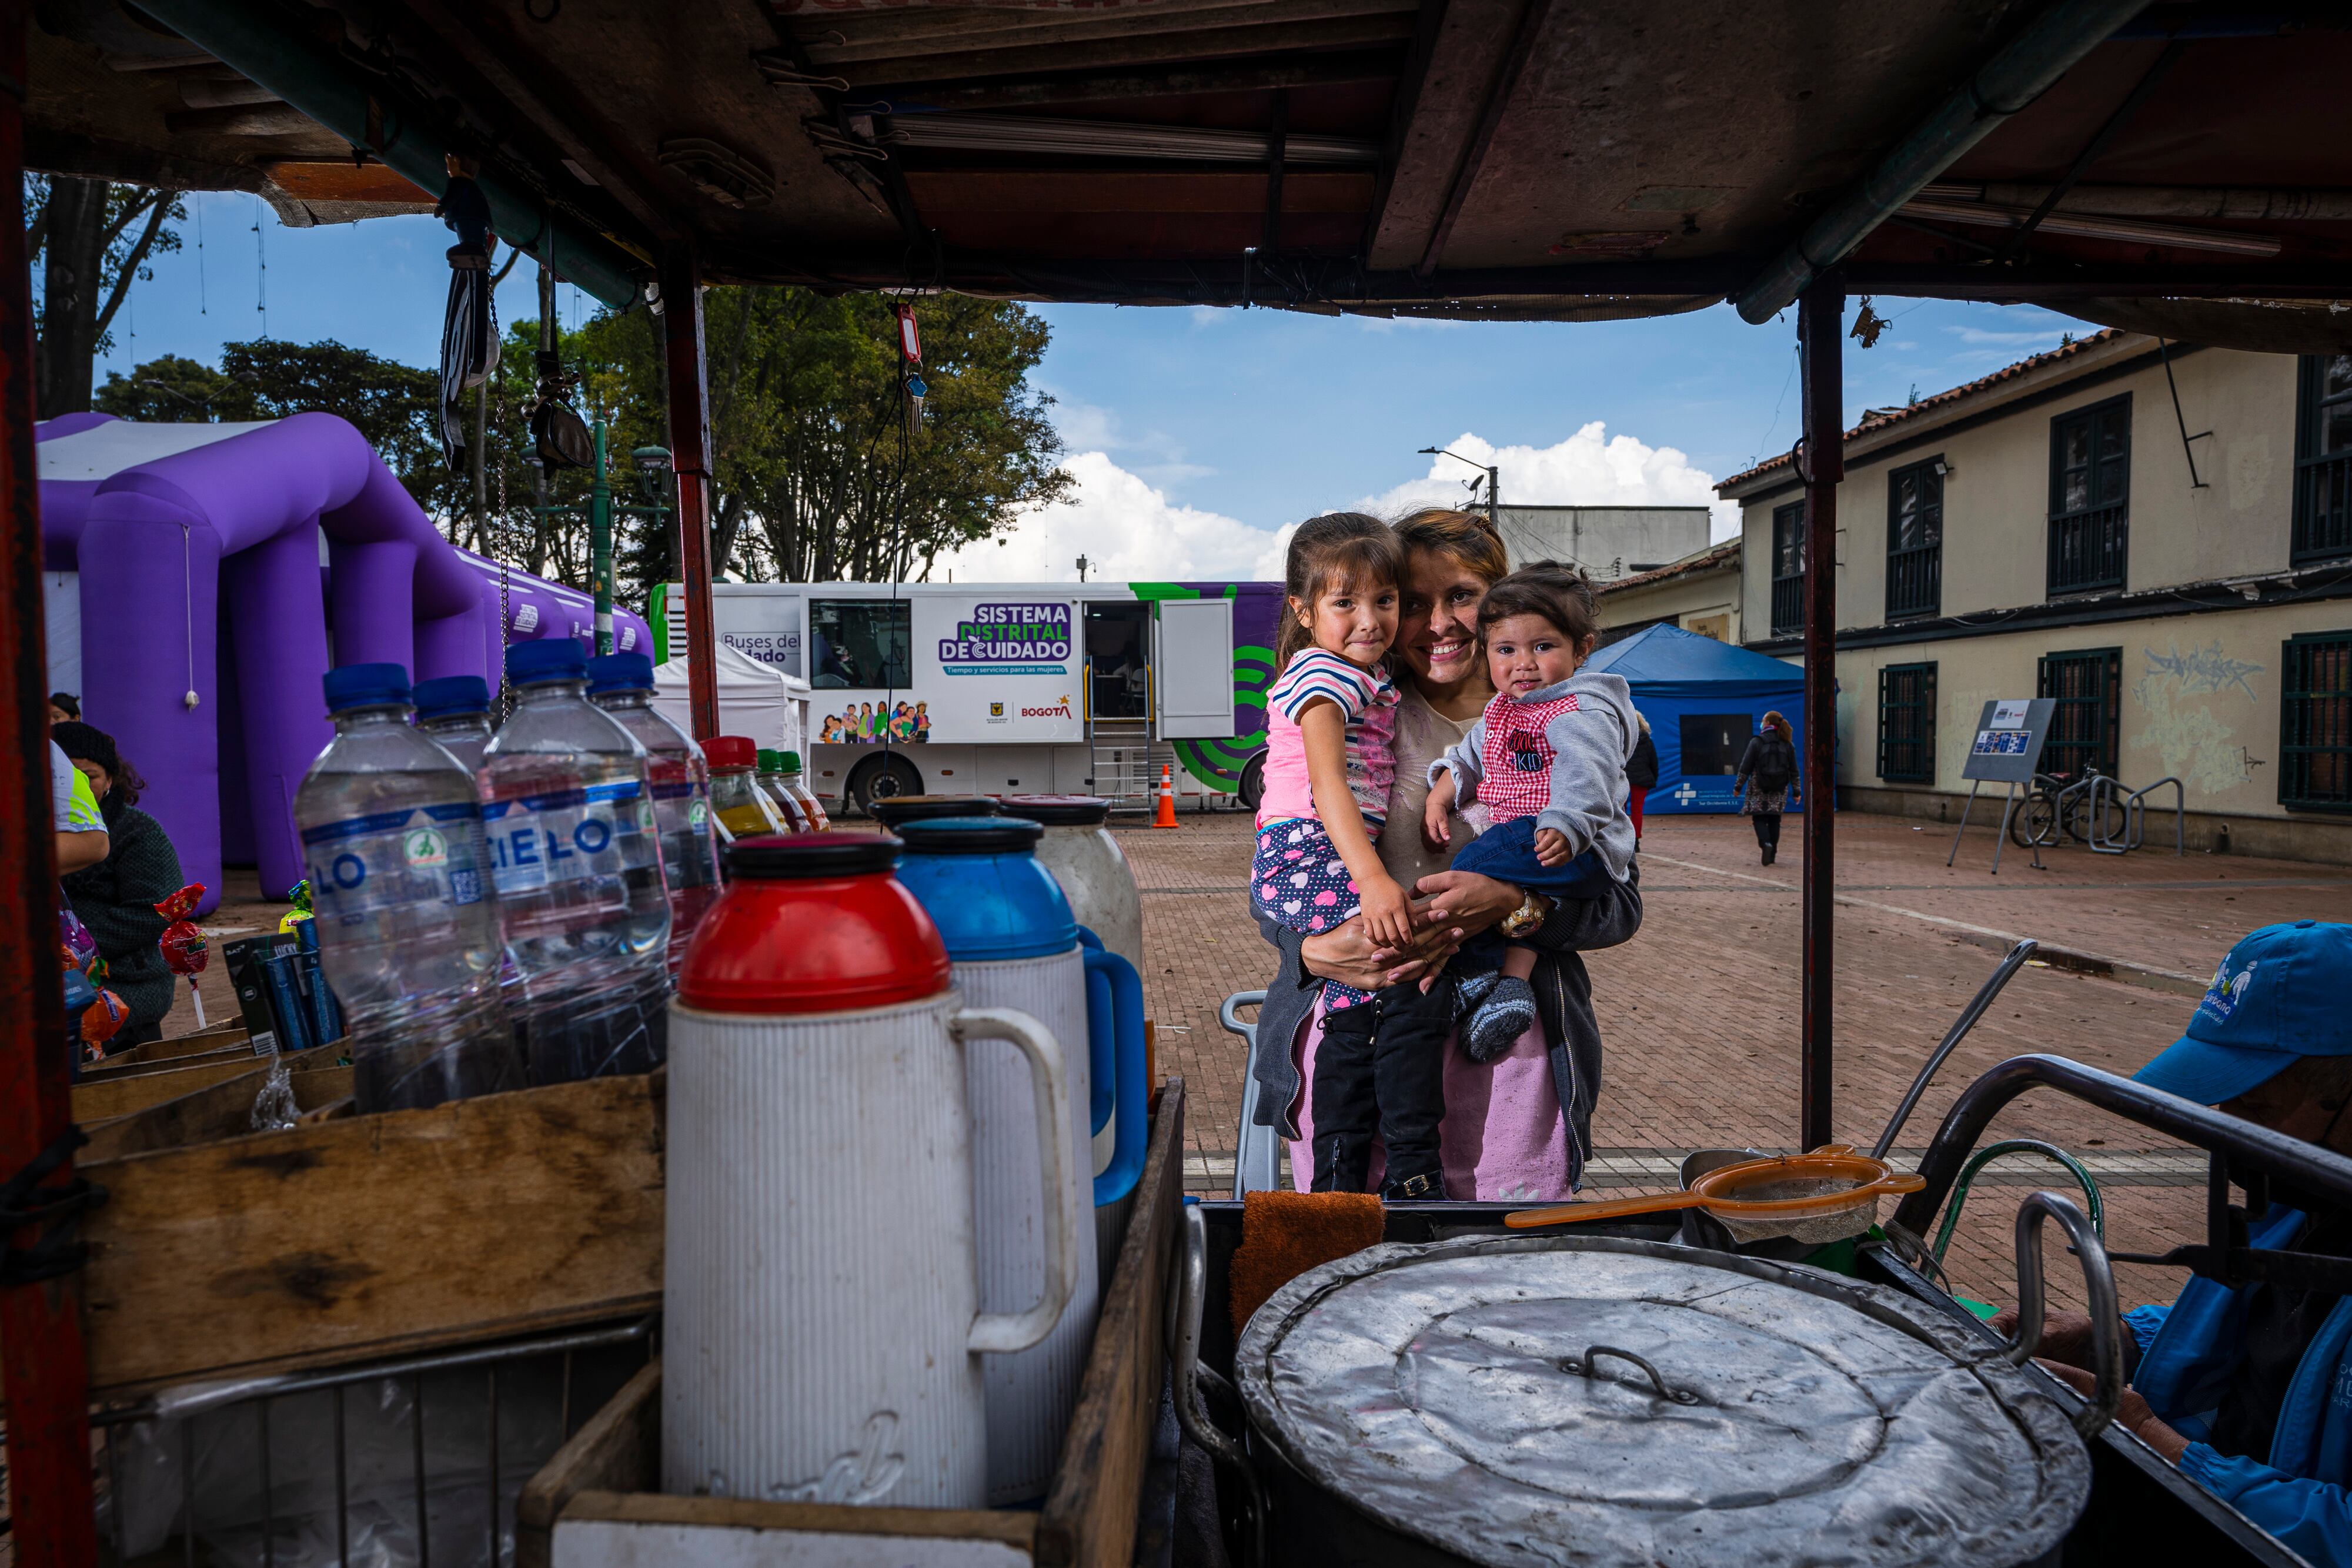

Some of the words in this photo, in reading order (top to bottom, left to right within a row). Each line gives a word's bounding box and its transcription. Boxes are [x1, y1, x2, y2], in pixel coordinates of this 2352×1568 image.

[977, 606, 1068, 623] SISTEMA
[724, 635, 771, 648] Buses
[777, 634, 801, 648] del
[960, 624, 1068, 641] DISTRITAL
[942, 642, 969, 659] DE
[971, 641, 1068, 658] CUIDADO
[1508, 731, 1534, 751] COOL
[1518, 754, 1541, 771] KID
[274, 943, 298, 958] LUCKY
